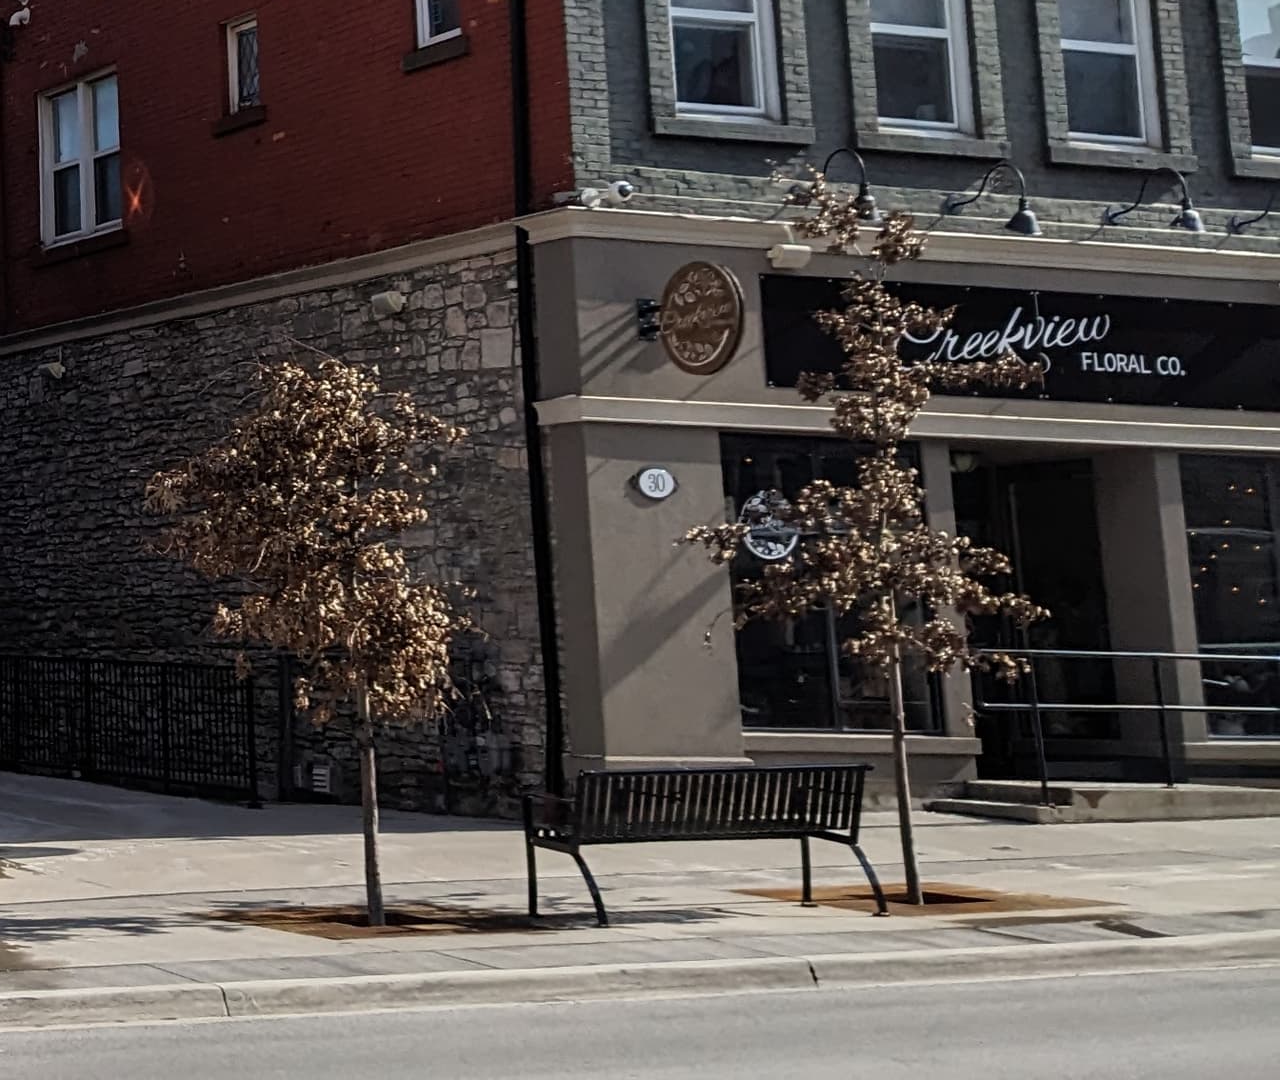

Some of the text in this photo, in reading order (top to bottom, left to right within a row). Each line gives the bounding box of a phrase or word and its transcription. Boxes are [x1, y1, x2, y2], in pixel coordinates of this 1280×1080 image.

[1081, 352, 1187, 376] FLORAL CO.
[647, 473, 666, 493] 30
